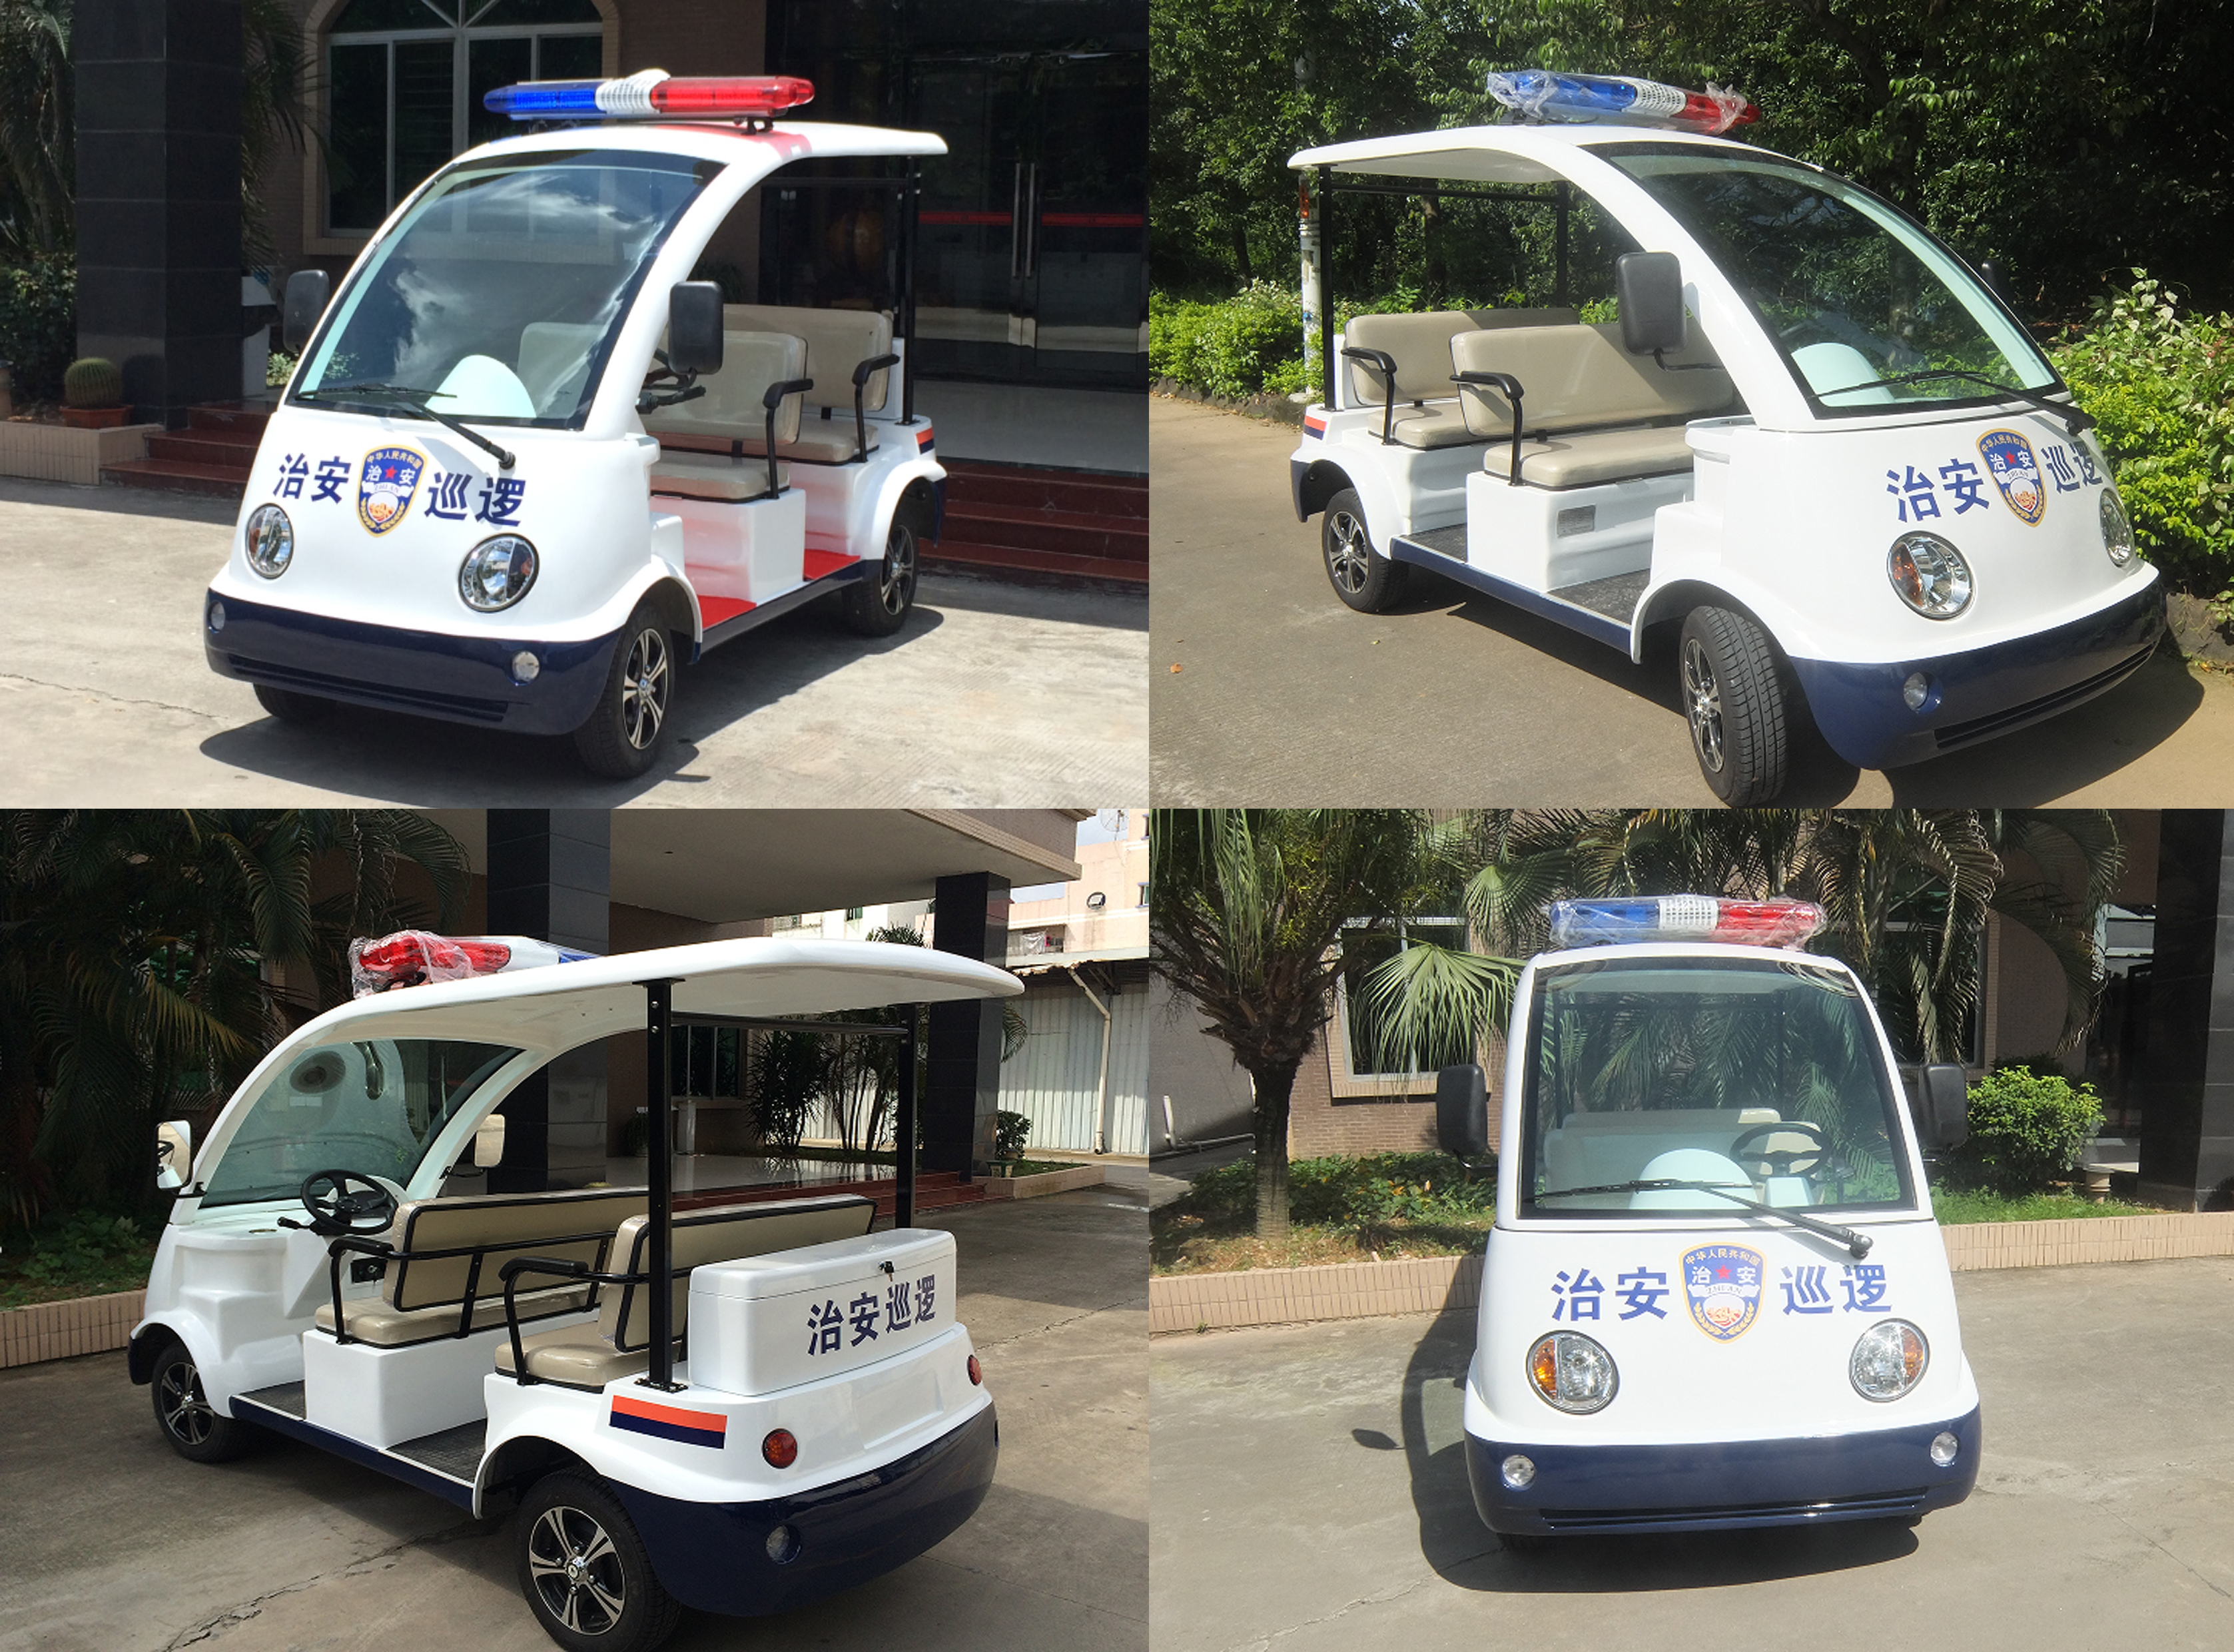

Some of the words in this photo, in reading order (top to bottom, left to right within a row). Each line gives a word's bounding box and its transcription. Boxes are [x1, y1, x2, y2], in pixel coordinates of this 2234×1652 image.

[272, 452, 352, 504] 治安
[424, 472, 526, 527] 巡逻
[1886, 458, 1990, 523] 治安
[2040, 441, 2103, 494] 巡逻
[807, 1274, 936, 1357] 治安巡逻
[1551, 1266, 1669, 1322] 治安
[1780, 1264, 1892, 1316] 巡逻
